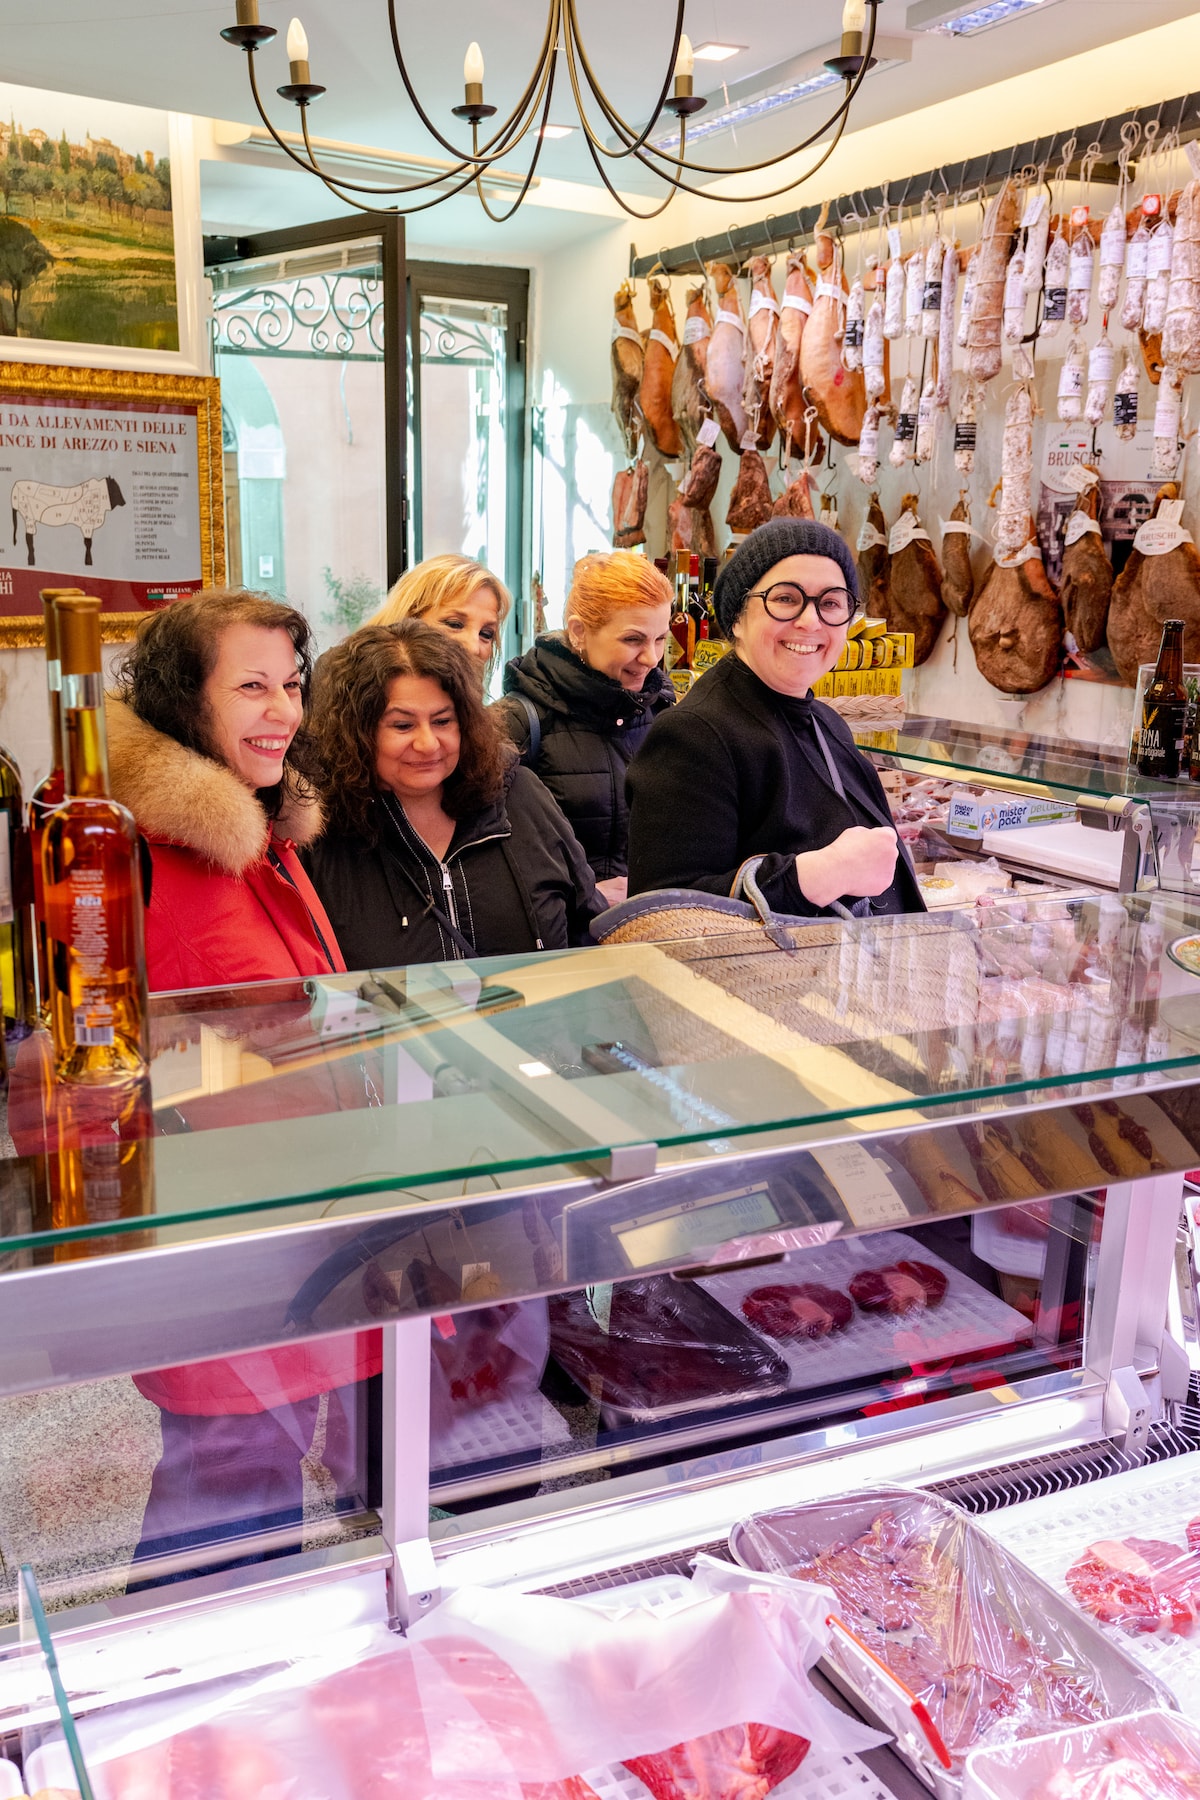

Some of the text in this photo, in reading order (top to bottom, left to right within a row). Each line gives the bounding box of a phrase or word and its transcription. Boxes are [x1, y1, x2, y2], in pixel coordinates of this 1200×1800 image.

[9, 413, 30, 427] DA
[35, 415, 138, 433] ALLEVAMENTI
[143, 421, 188, 436] DELLE
[41, 436, 56, 450] DI
[62, 437, 118, 452] AREZZO
[124, 440, 132, 452] E
[137, 440, 177, 454] SIENA
[1048, 451, 1101, 466] BRUSCHI
[1140, 531, 1177, 542] BRUSCHI
[954, 803, 974, 813] mister
[999, 805, 1027, 818] mister
[998, 815, 1021, 829] pack
